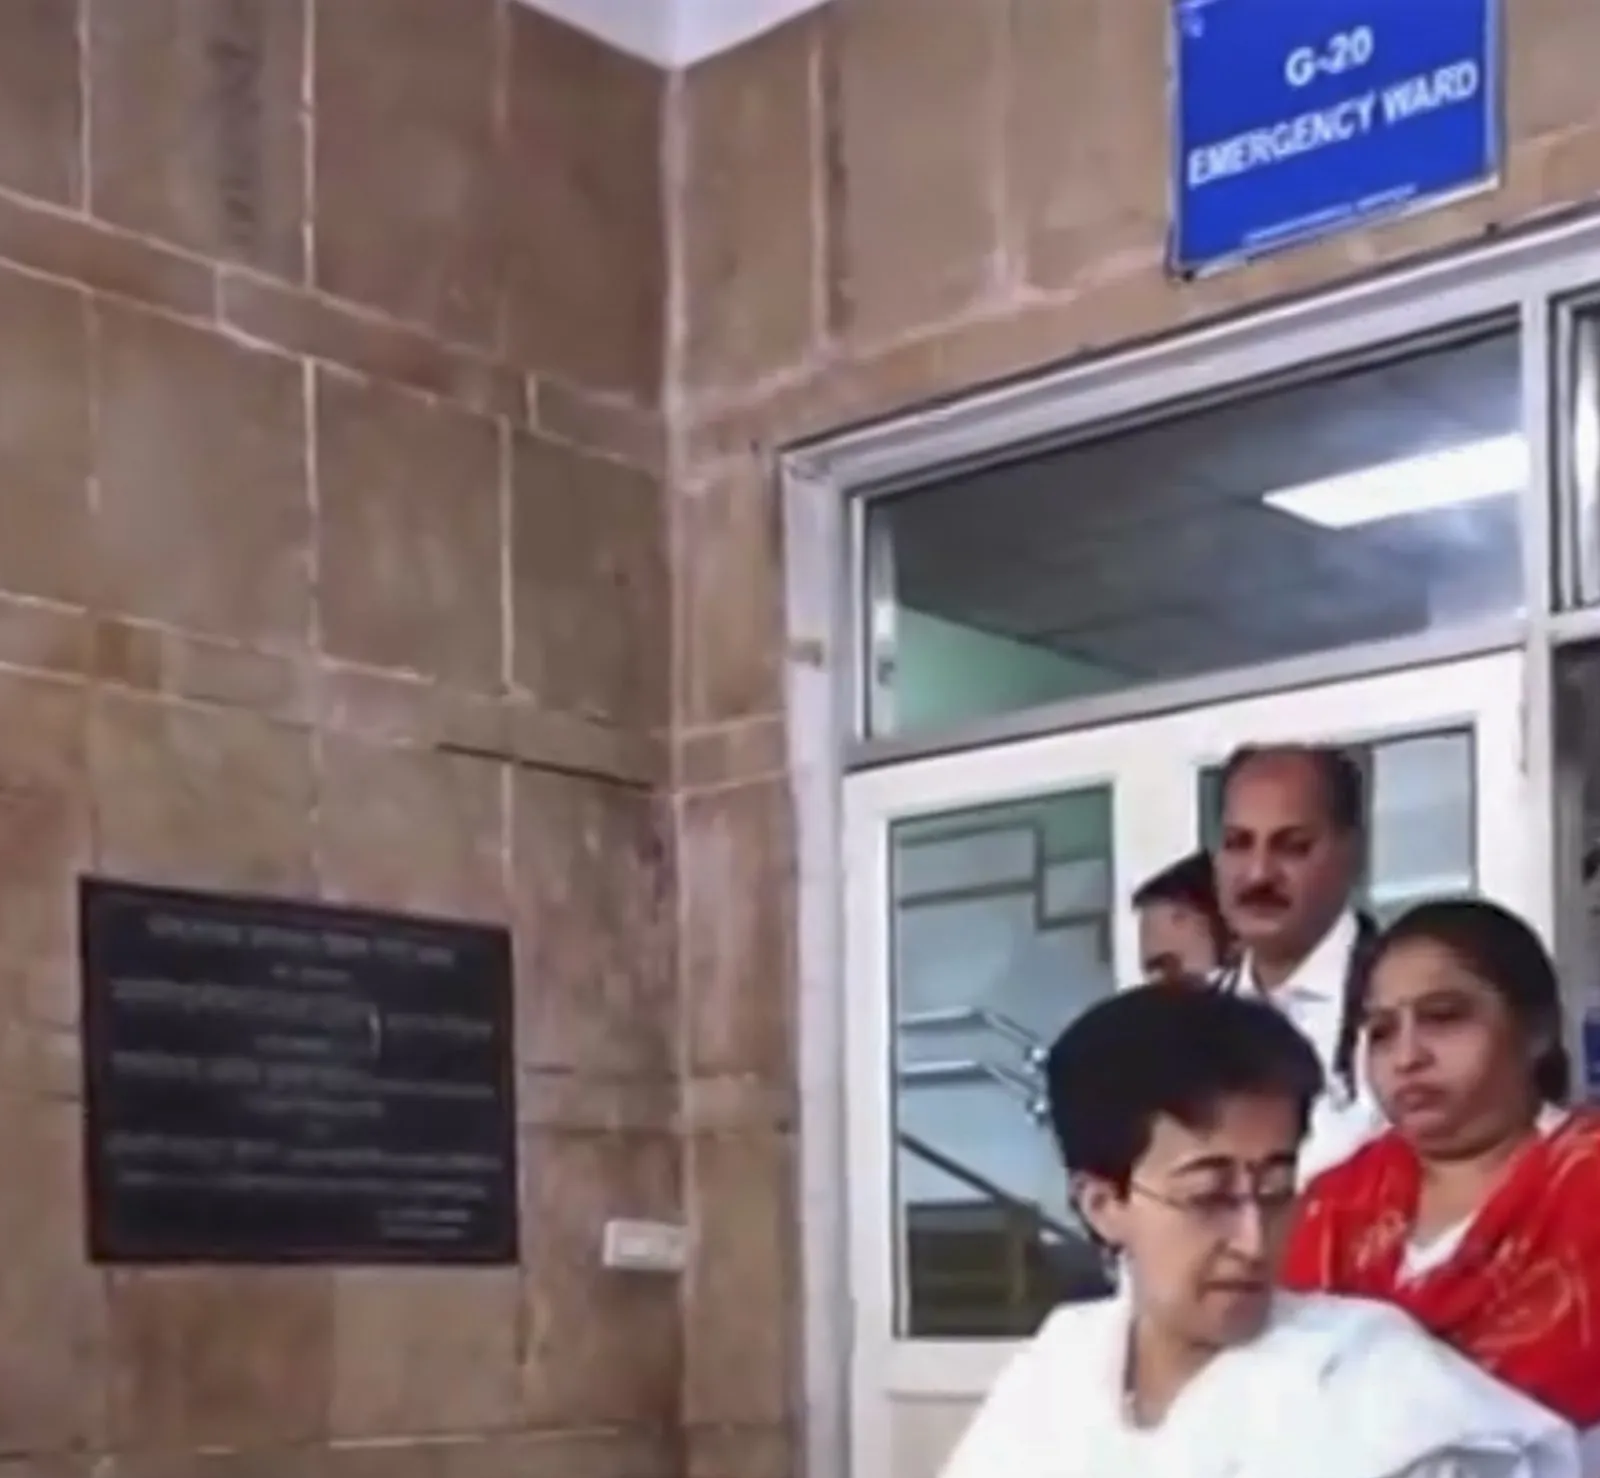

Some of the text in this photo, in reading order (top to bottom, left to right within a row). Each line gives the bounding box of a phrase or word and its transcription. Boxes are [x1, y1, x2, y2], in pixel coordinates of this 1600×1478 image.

[1285, 25, 1374, 87] G-20
[1188, 60, 1478, 189] EMERGENCY WARD
